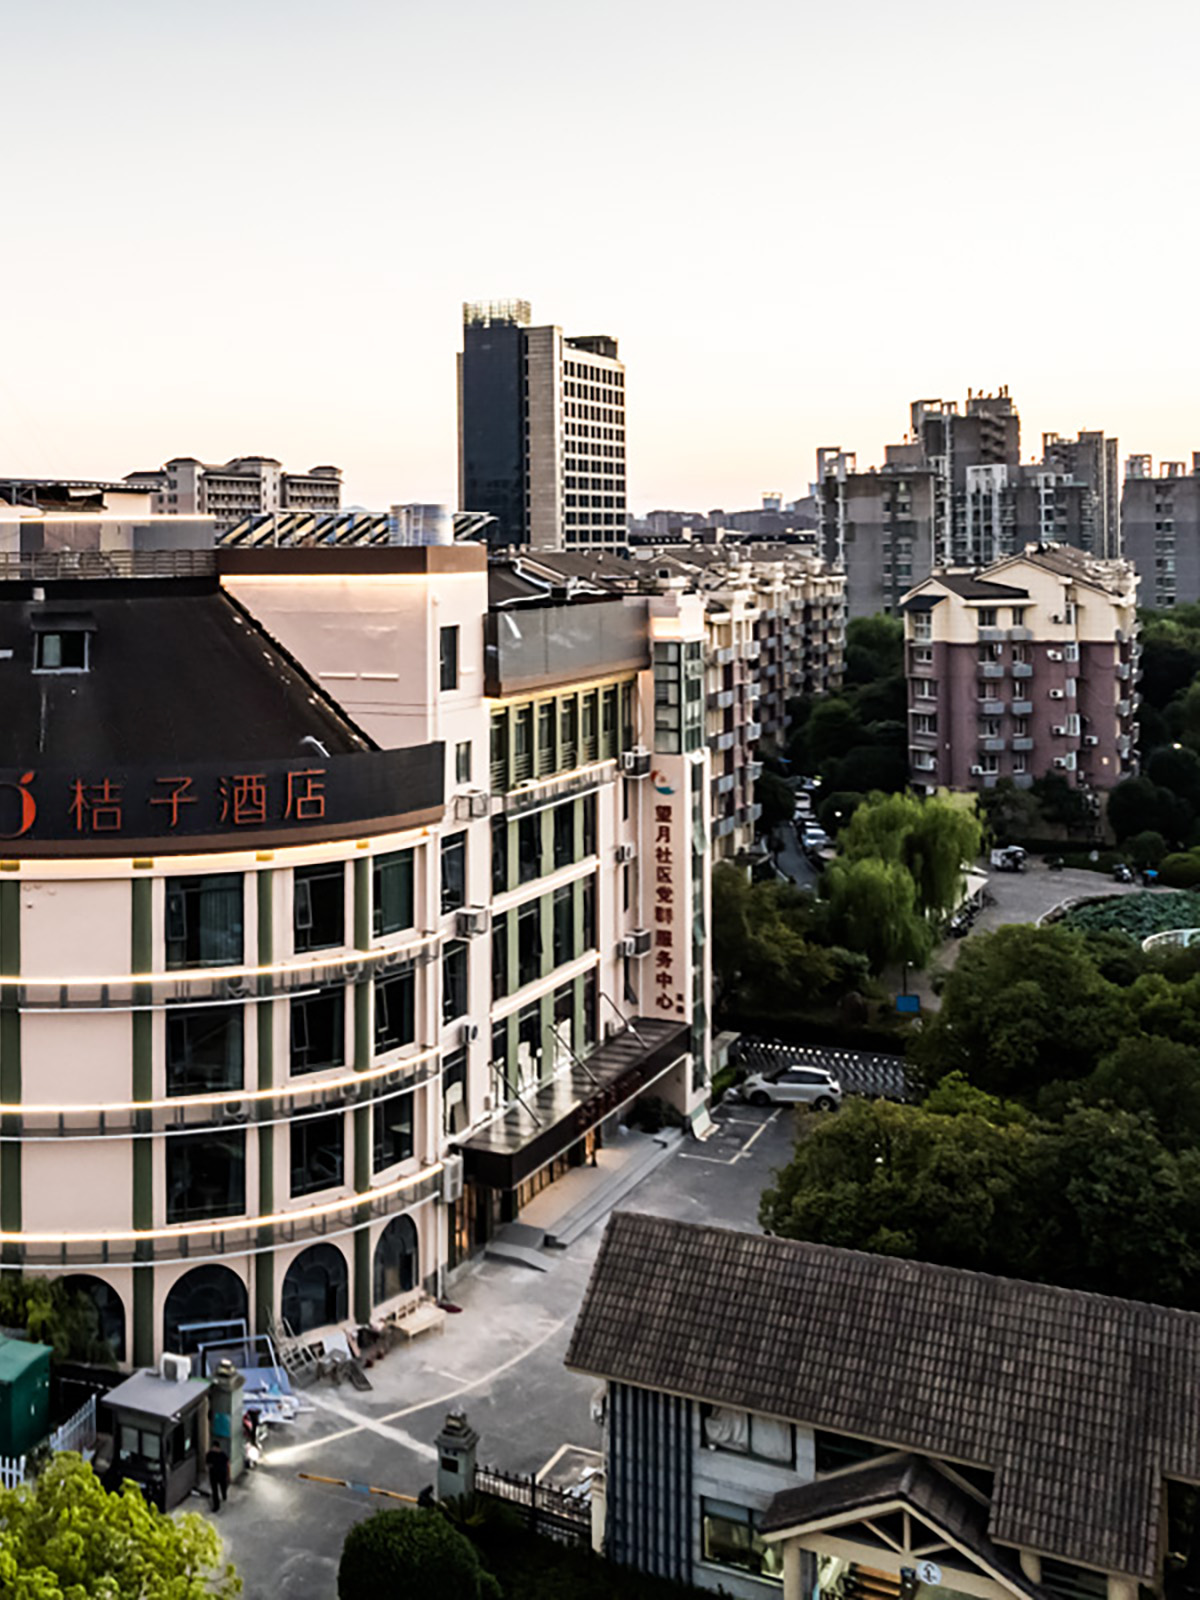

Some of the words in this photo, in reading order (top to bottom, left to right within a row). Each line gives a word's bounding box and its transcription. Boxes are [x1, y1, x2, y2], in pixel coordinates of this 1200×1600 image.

[68, 768, 327, 833] 桔子酒店
[654, 805, 674, 1010] 望月社区党群服务中心
